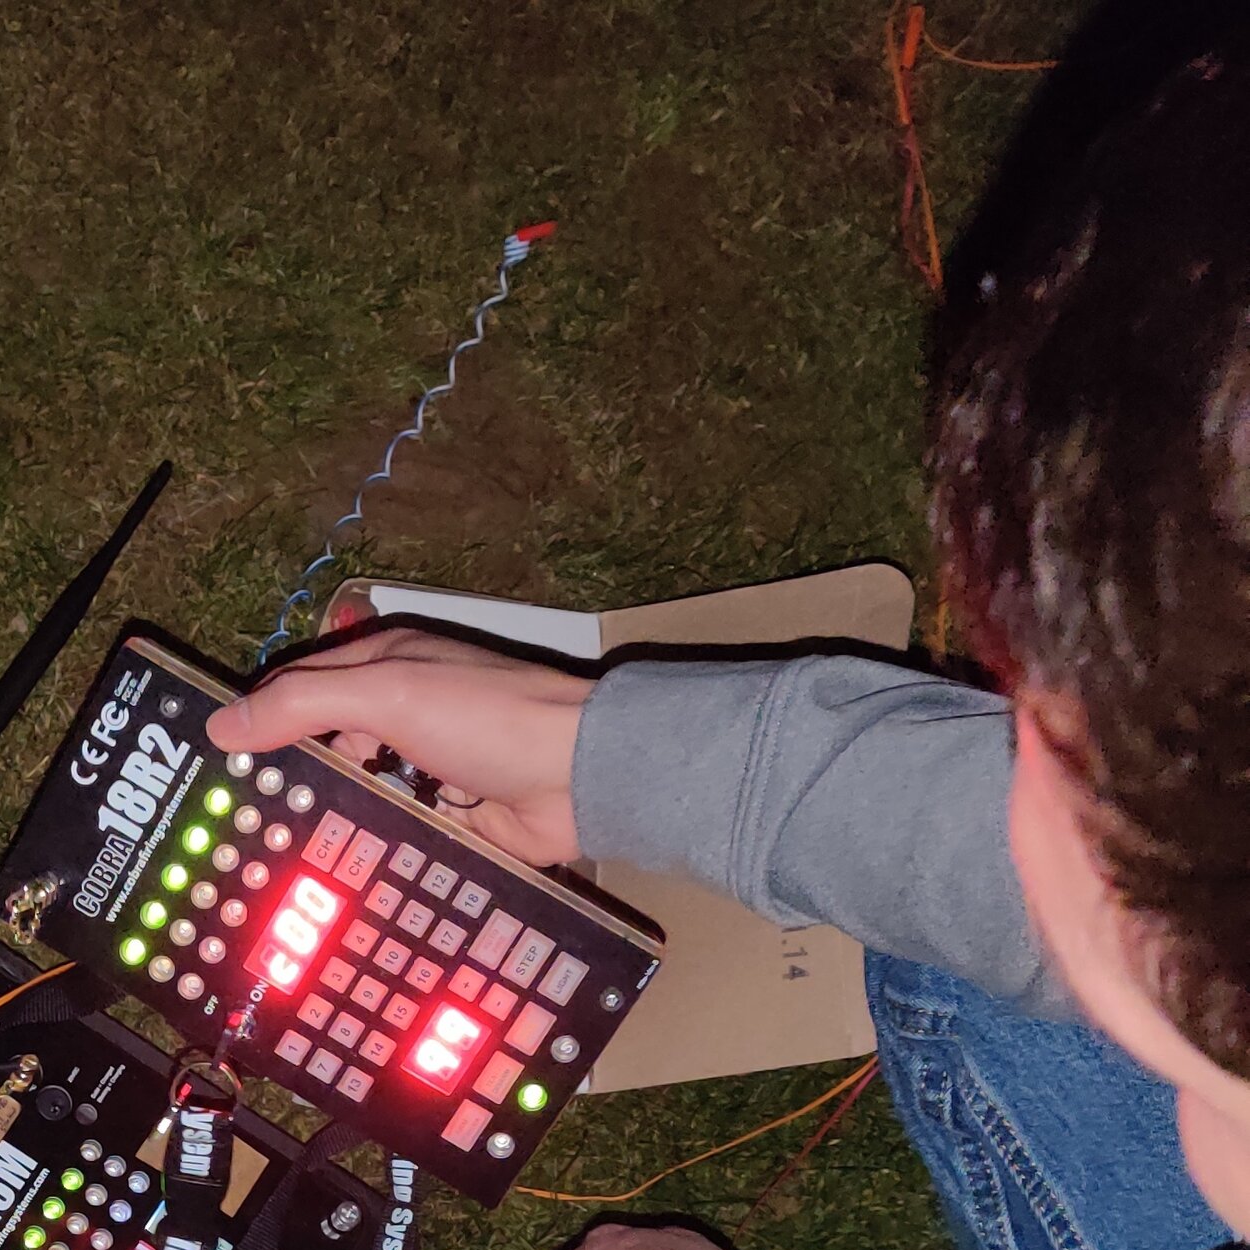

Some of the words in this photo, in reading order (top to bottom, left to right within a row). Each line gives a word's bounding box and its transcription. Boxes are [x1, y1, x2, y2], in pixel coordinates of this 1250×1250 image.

[97, 723, 191, 842] 18R2
[105, 755, 205, 923] www.cobrafiringsystems.com
[314, 838, 334, 861] CH
[347, 854, 367, 878] CH
[72, 833, 136, 918] COBRA
[286, 1043, 299, 1055] 1
[308, 1007, 322, 1020] 2
[331, 971, 344, 983] 3
[354, 934, 367, 946] 4
[377, 895, 390, 907] 5
[400, 857, 414, 870] 6
[316, 1062, 329, 1074] 7
[339, 1026, 352, 1038] 8
[362, 989, 375, 1001] 9
[384, 949, 400, 967] 10
[407, 912, 423, 929] 11
[430, 873, 447, 892] 12
[514, 943, 541, 978] STEP
[551, 966, 575, 996] LIGHT
[203, 994, 219, 1015] OFF
[249, 982, 269, 1002] ON
[346, 1077, 363, 1095] 13
[368, 1041, 385, 1059] 14
[392, 1004, 409, 1022] 15
[415, 967, 432, 986] 16
[439, 930, 456, 948] 17
[462, 892, 480, 911] 18
[417, 1009, 479, 1072] 99
